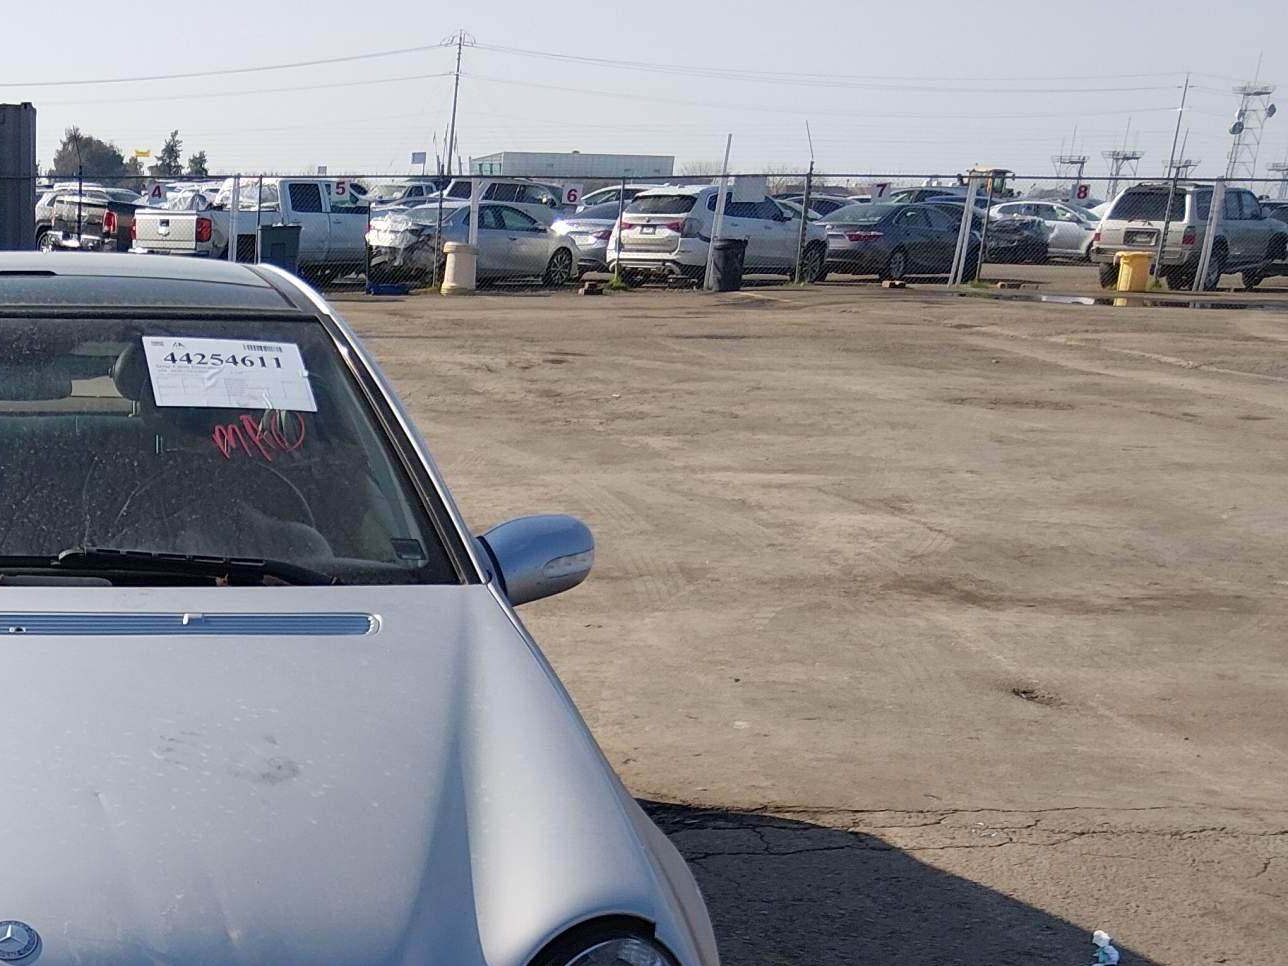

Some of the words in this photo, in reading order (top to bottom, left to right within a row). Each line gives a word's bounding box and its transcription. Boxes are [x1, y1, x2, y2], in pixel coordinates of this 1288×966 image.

[151, 185, 162, 199] 4
[335, 182, 346, 196] 5
[567, 189, 577, 203] 6
[876, 184, 887, 198] 7
[1077, 185, 1088, 200] 8
[164, 351, 283, 369] 44254611
